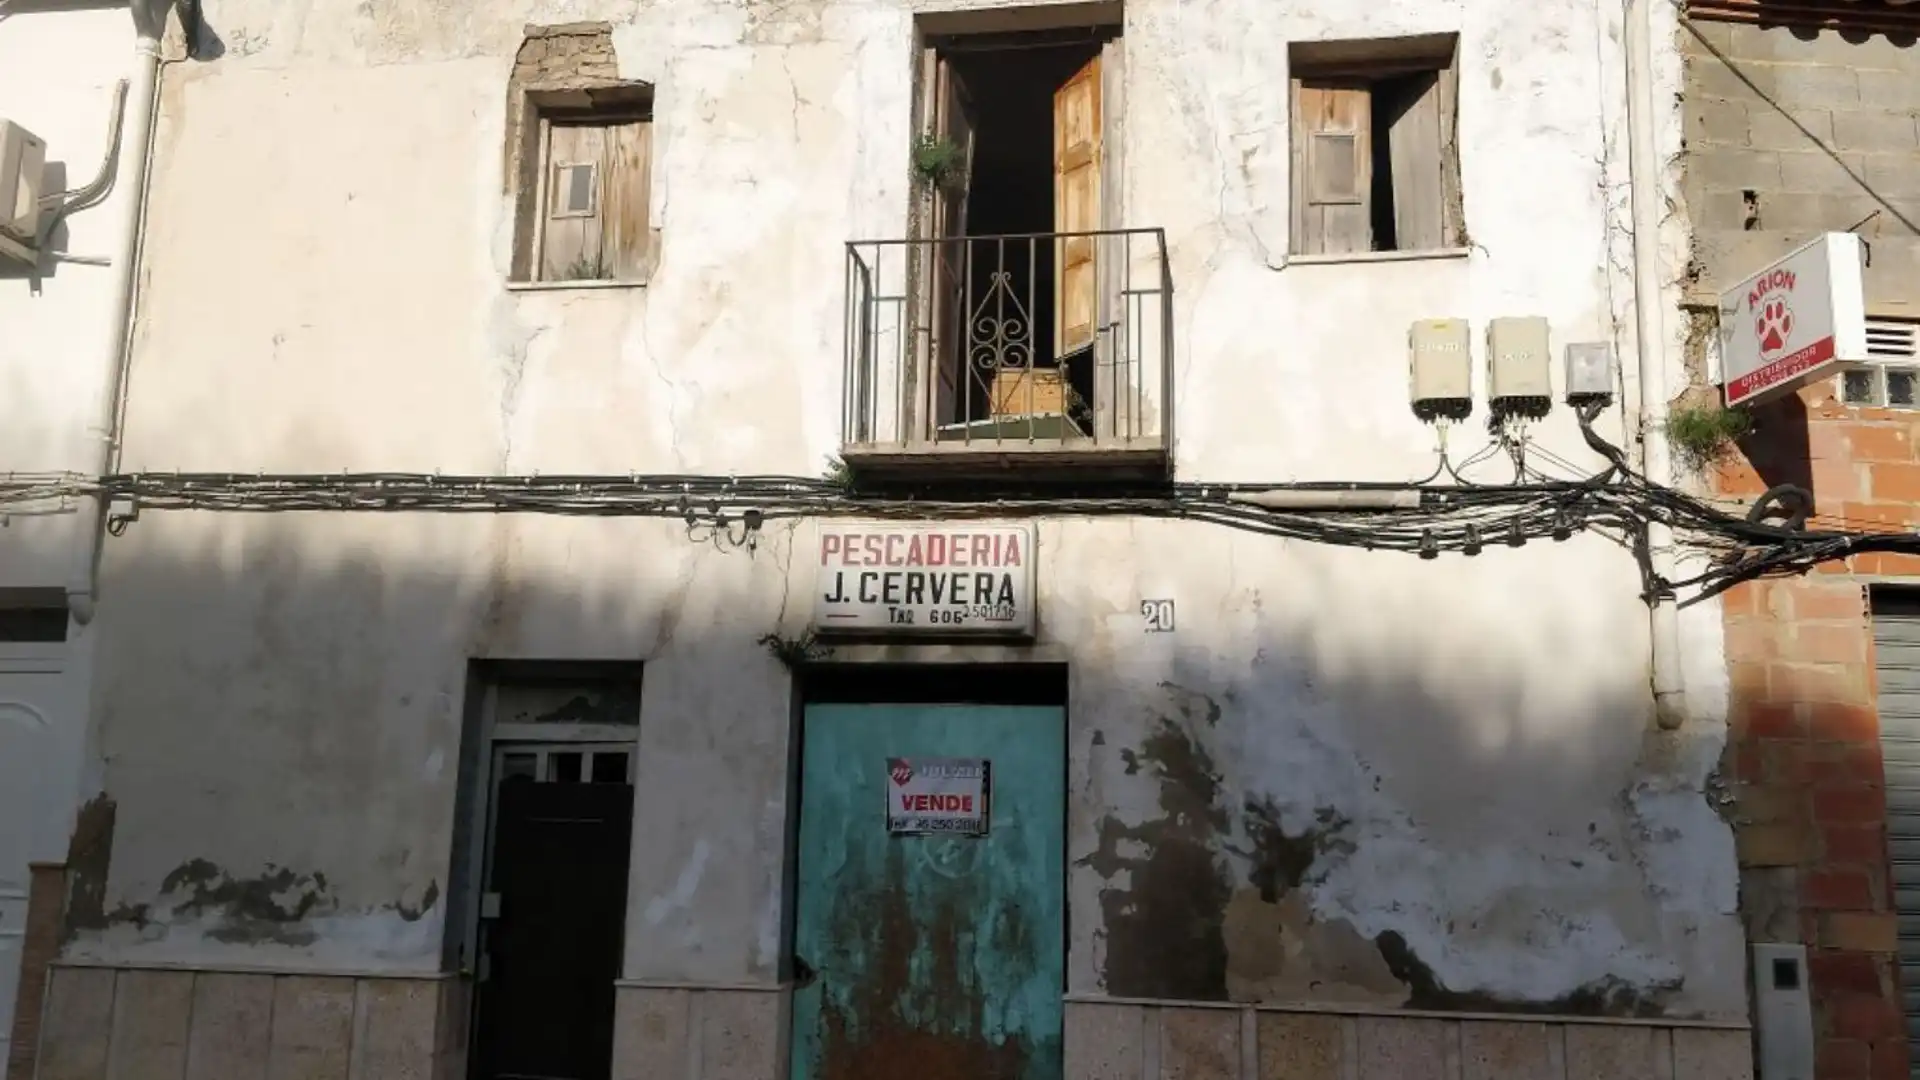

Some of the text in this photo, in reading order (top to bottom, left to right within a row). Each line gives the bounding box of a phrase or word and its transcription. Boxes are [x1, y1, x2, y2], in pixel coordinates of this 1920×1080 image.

[1748, 269, 1796, 312] ARION
[1741, 345, 1817, 387] DISTRIBDOR
[821, 533, 1021, 567] PESCADERIA
[930, 608, 963, 624] 606
[1142, 600, 1174, 631] 20
[901, 794, 973, 813] VENDE
